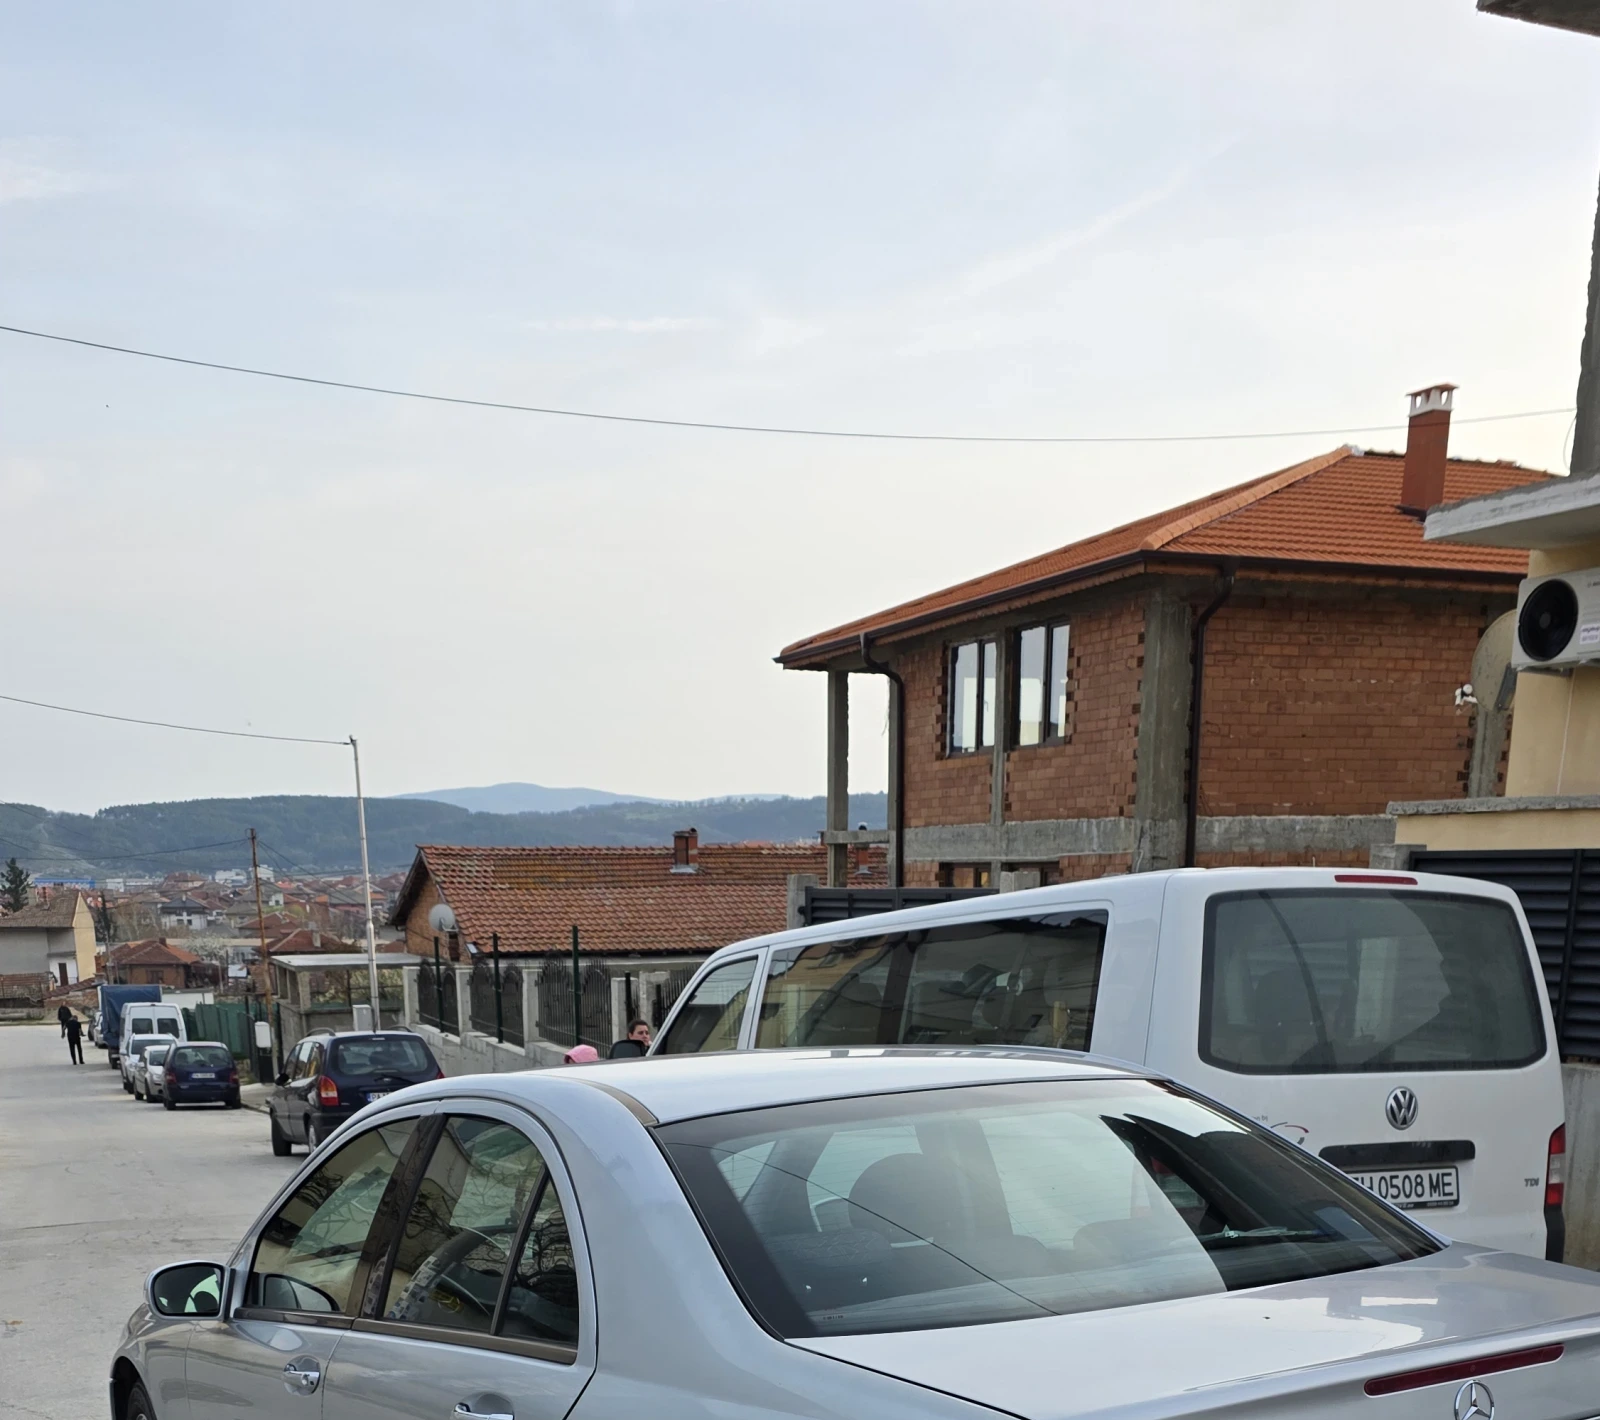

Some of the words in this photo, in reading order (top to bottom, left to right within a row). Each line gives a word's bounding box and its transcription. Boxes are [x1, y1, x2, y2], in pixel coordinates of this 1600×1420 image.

[1352, 1176, 1374, 1192] H
[1378, 1174, 1425, 1199] 0508
[1428, 1172, 1454, 1197] ME
[1524, 1177, 1540, 1187] TDI
